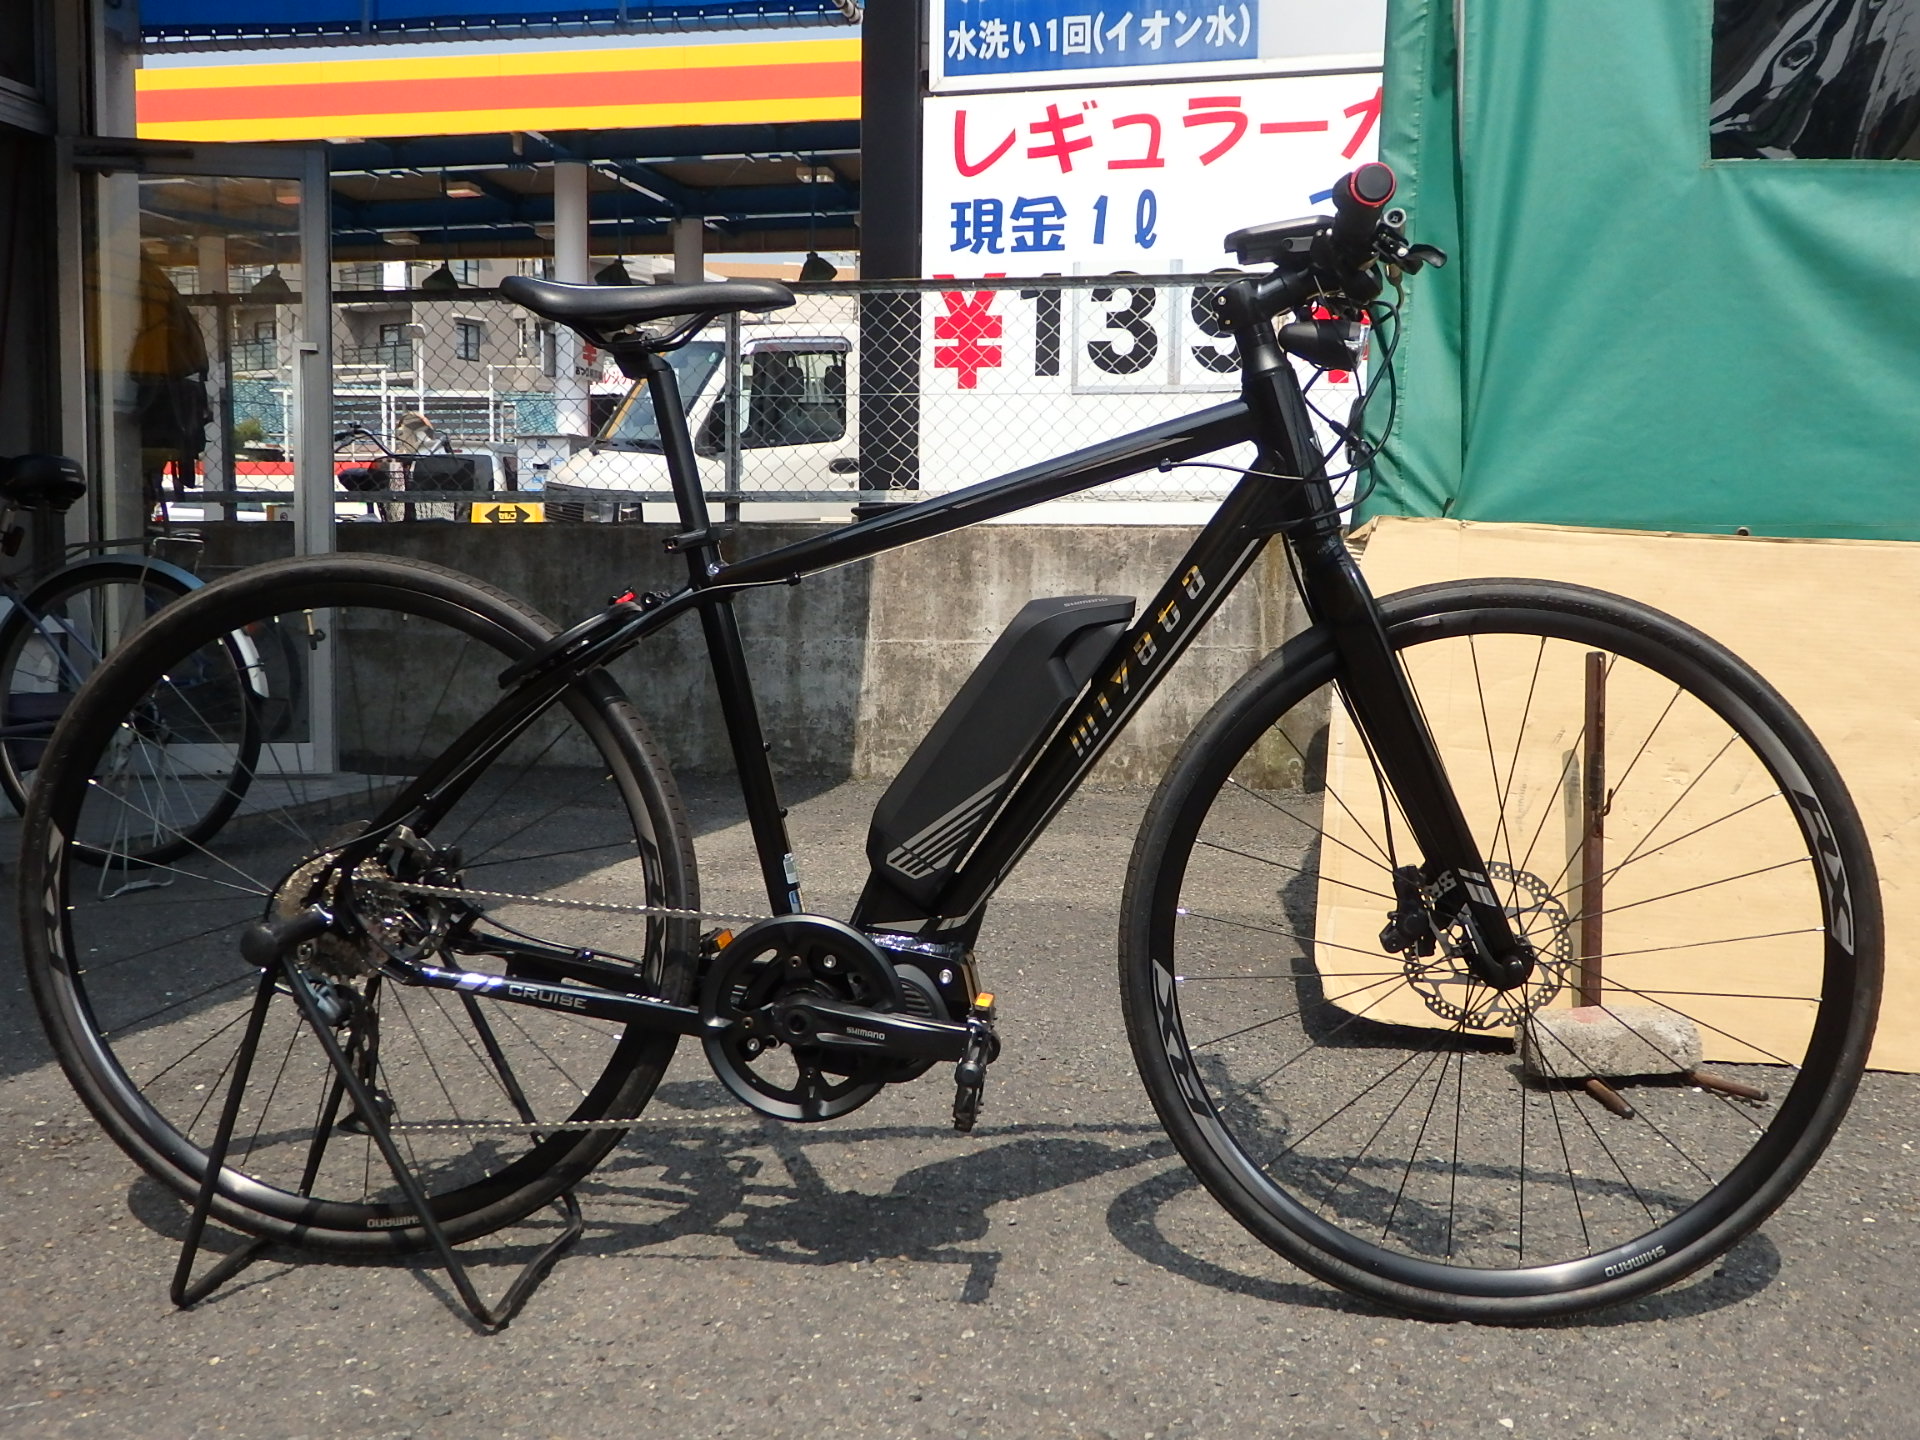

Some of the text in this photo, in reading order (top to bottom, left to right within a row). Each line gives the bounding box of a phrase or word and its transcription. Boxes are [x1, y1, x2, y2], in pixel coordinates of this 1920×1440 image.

[947, 2, 1251, 61] 水洗い1回(イオン水)
[949, 195, 1068, 255] 現金
[507, 983, 589, 1011] CRUISE
[846, 1026, 886, 1041] SHIMANO
[1603, 1244, 1667, 1278] SHIMANO
